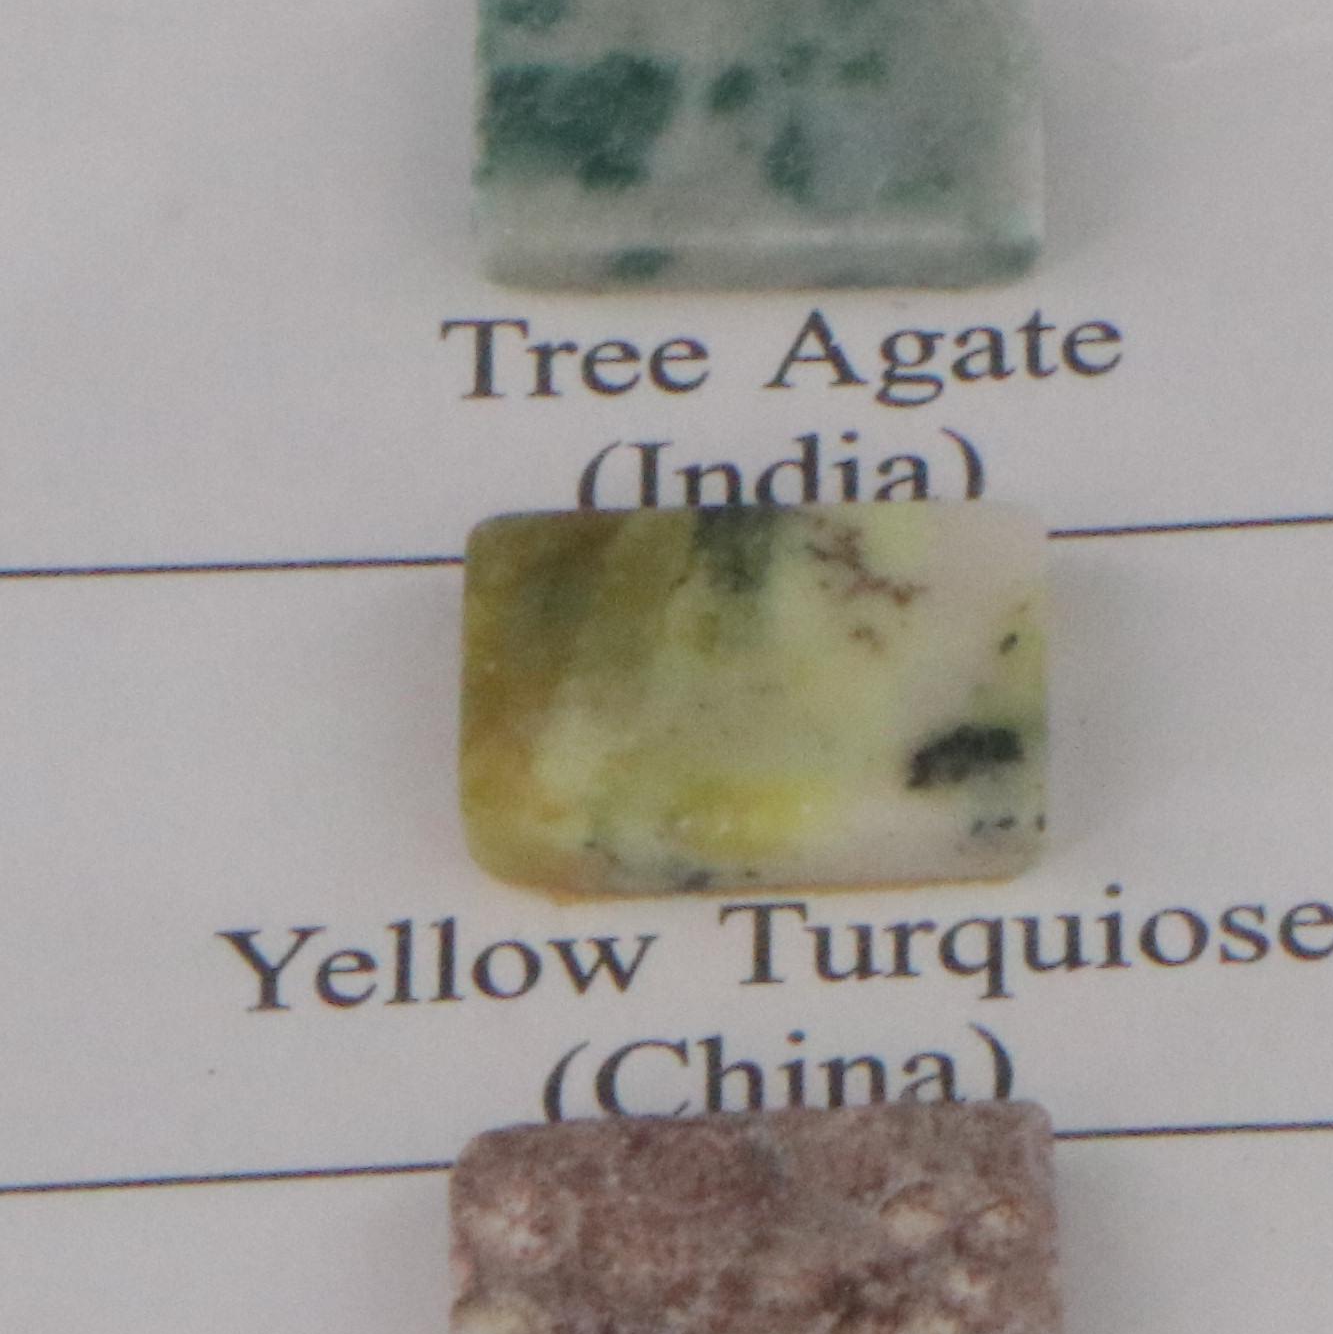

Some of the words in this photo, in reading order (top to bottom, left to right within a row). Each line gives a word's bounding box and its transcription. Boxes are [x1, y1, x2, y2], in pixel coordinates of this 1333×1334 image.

[440, 317, 711, 400] Tree
[763, 308, 1123, 408] Agate
[577, 427, 986, 510] (India)
[216, 915, 660, 1013] Yellow
[543, 1021, 1015, 1124] (China)
